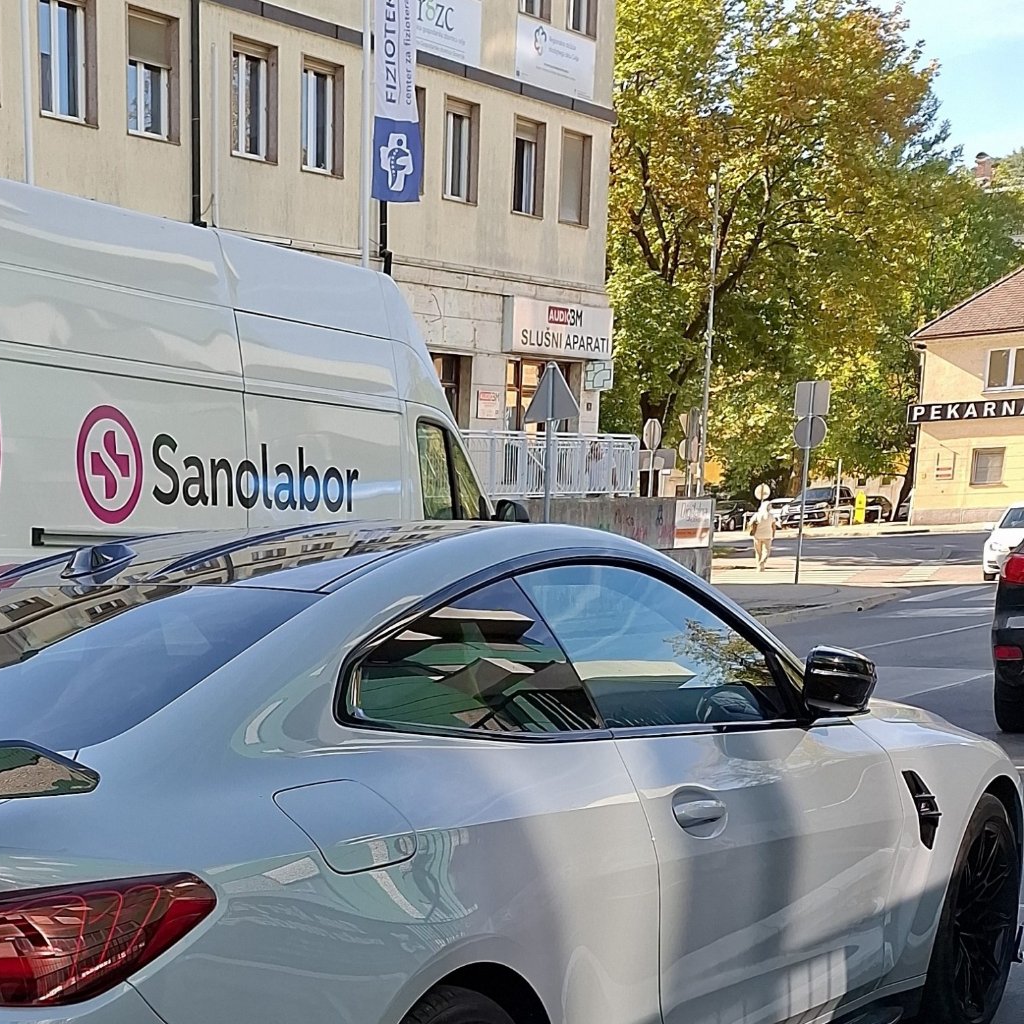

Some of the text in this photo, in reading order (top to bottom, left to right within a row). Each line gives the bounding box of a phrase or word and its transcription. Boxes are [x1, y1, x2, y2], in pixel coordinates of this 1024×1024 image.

[405, 52, 412, 64] za
[521, 327, 609, 353] SLUŠNI APARATI
[152, 433, 359, 513] Sanolabor
